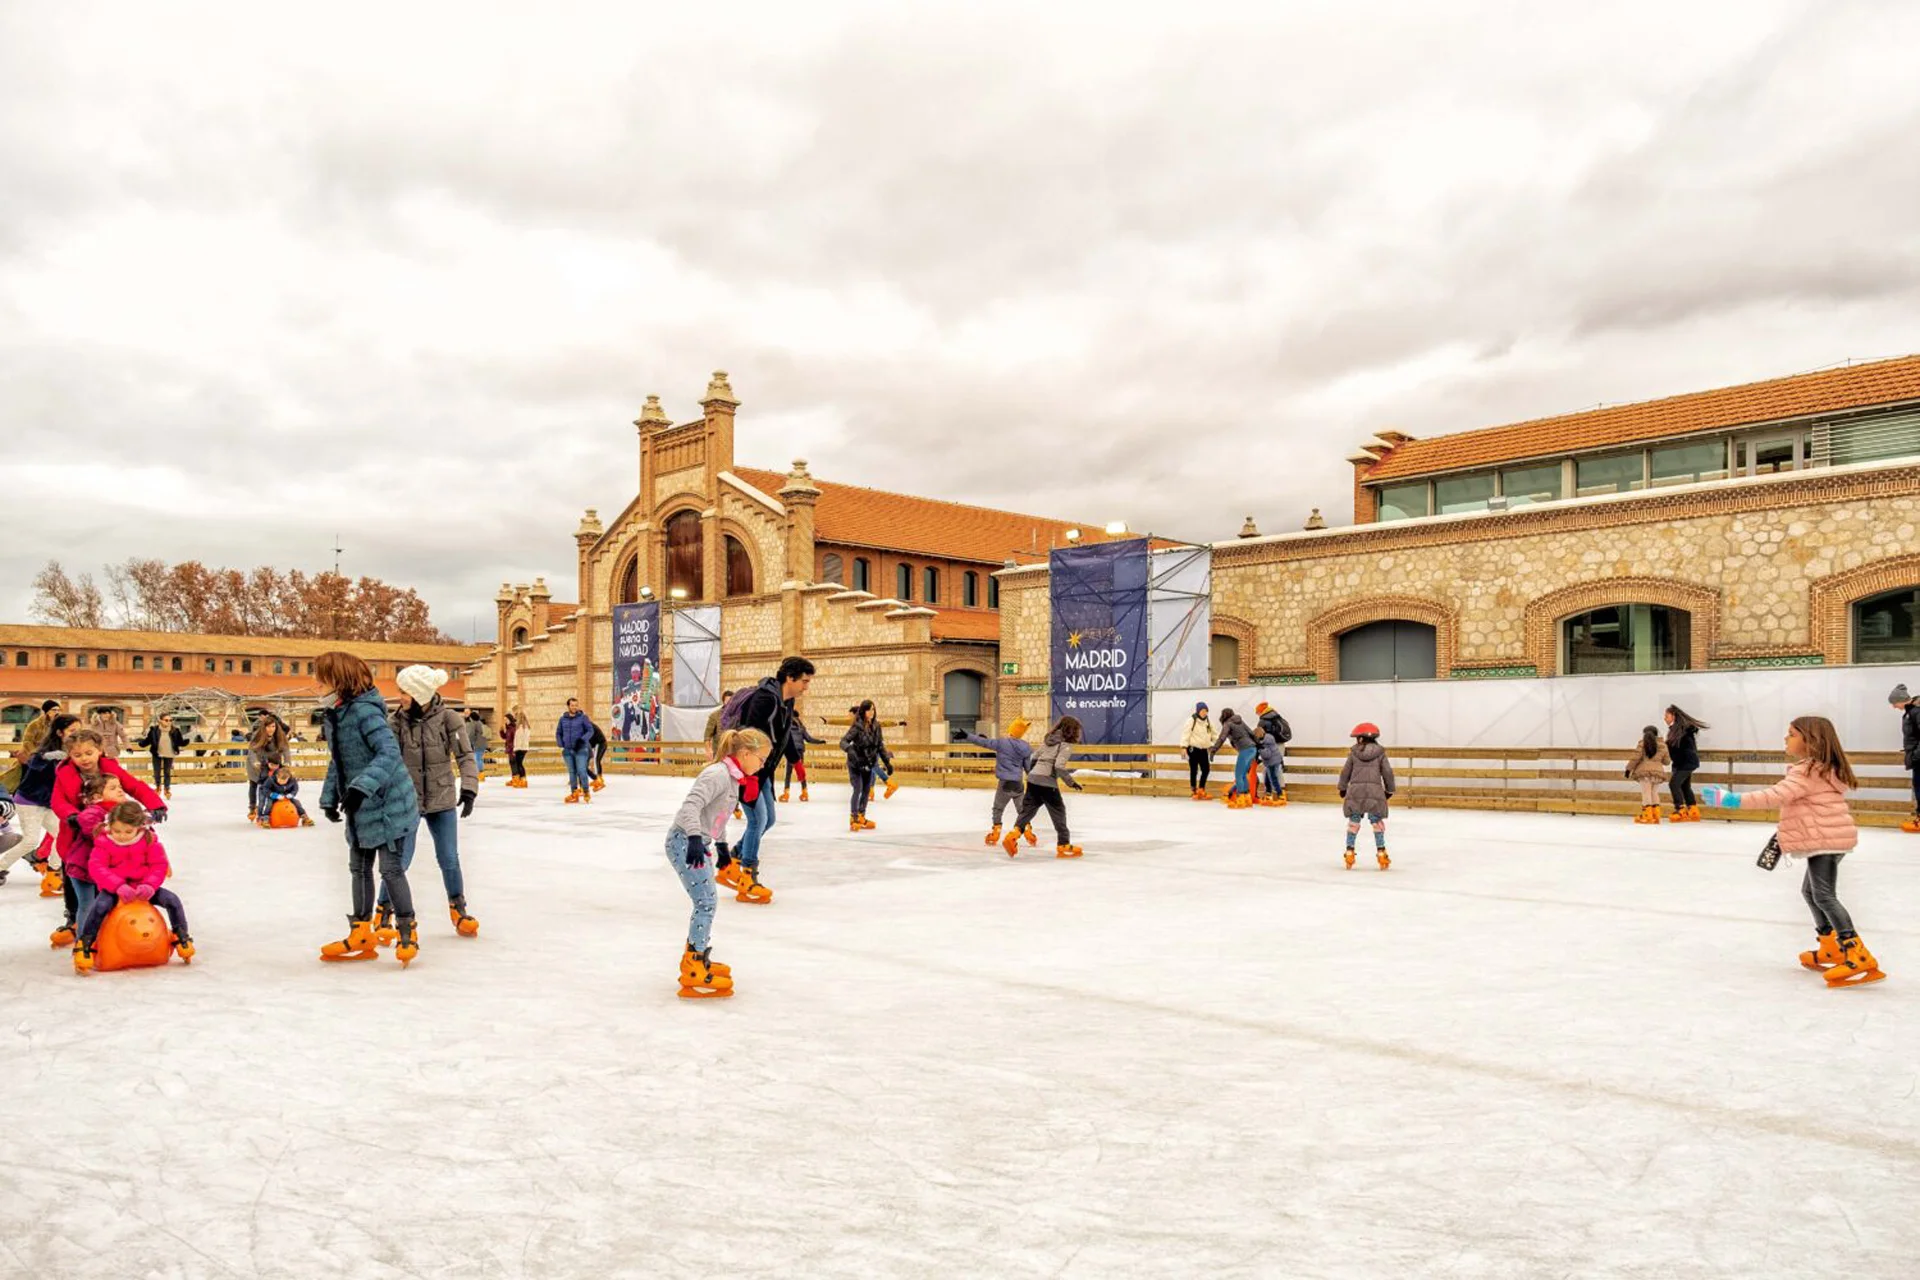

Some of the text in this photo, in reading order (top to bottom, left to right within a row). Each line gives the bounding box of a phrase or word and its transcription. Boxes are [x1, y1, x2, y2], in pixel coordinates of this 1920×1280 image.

[620, 620, 649, 634] MADRID
[643, 634, 648, 642] a
[619, 644, 648, 657] NAVIDAD
[1065, 648, 1127, 670] MADRID
[1065, 672, 1127, 692] NAVIDAD
[1065, 695, 1127, 709] de encuentro
